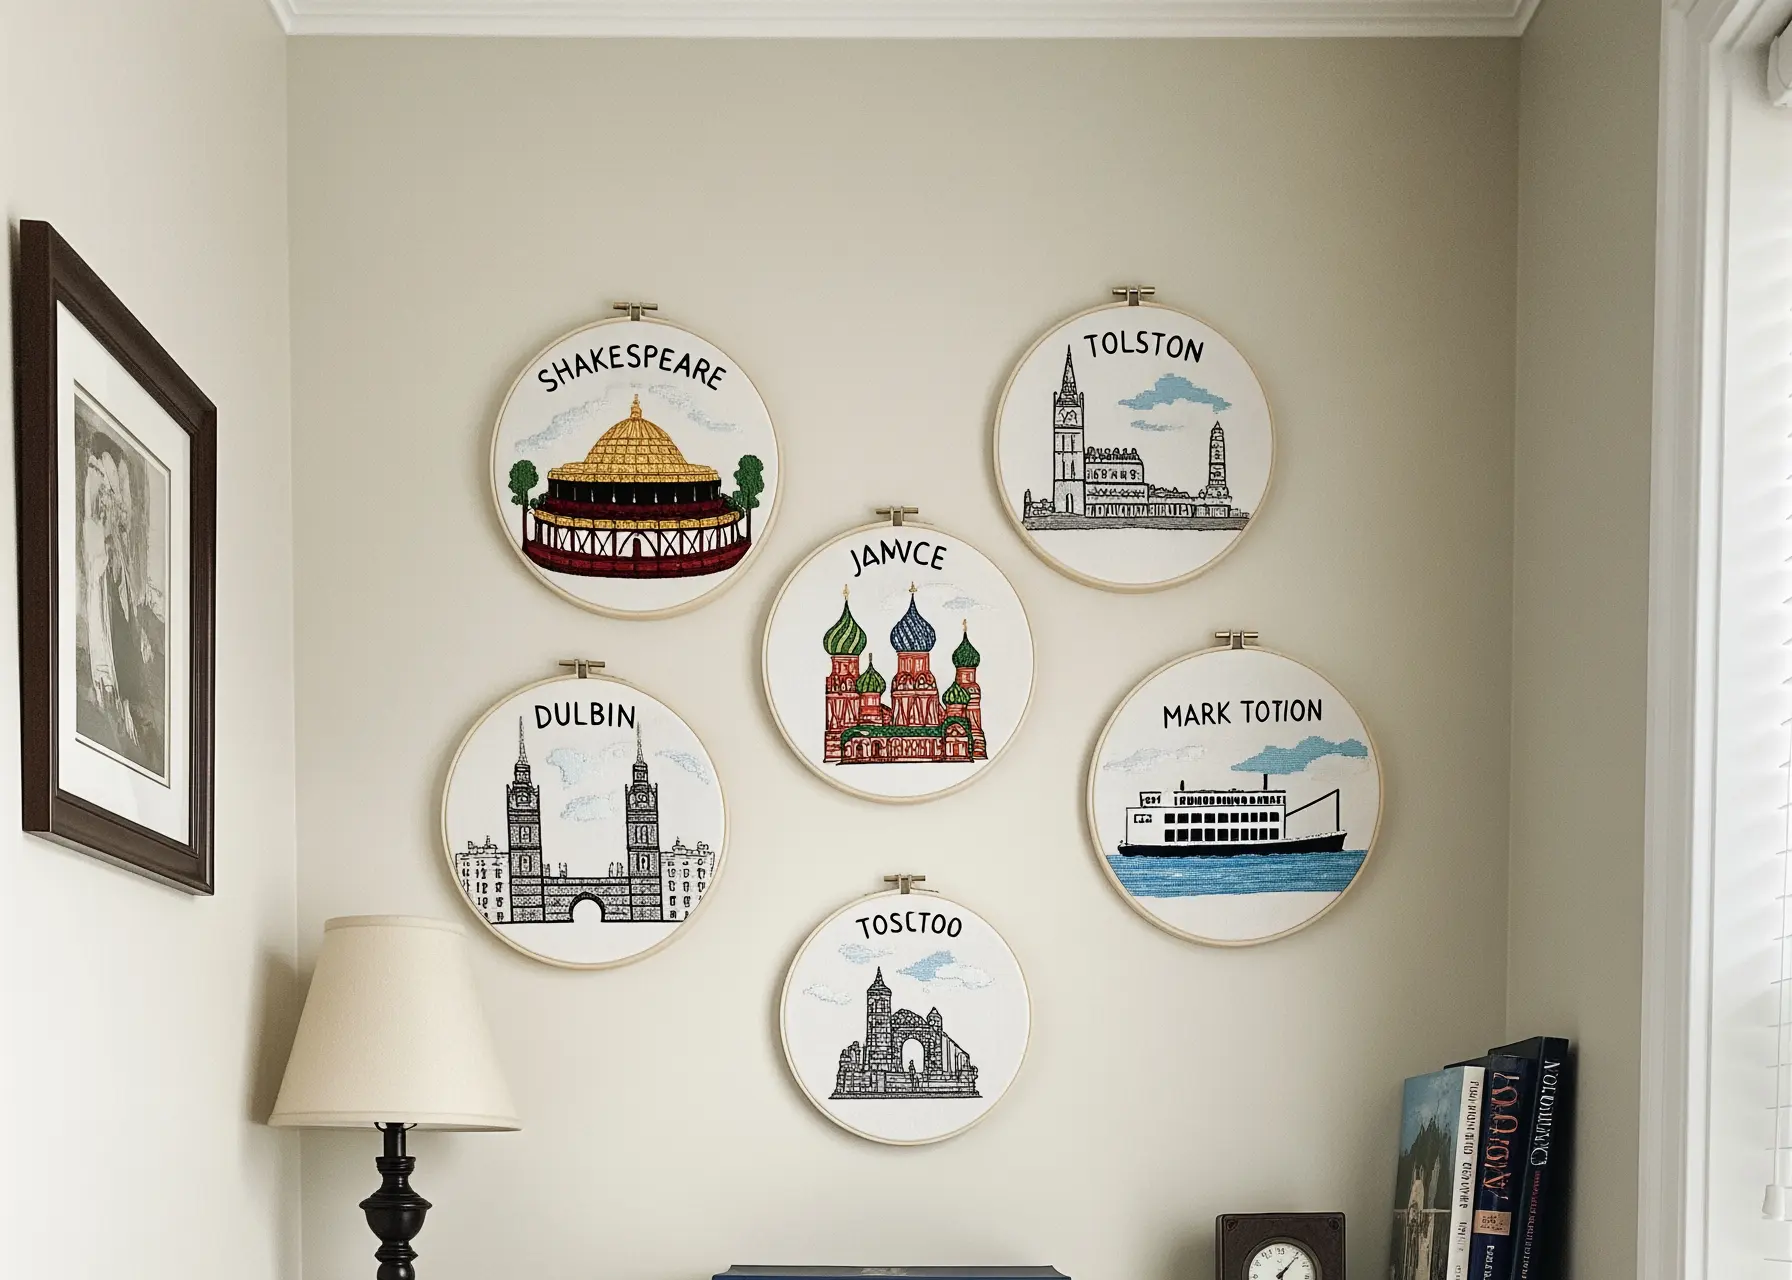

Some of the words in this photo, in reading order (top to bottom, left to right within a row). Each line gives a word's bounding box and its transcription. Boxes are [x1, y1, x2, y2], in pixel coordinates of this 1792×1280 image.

[1083, 330, 1204, 363] TOLSTON
[537, 343, 727, 393] SHAKESPEARE
[534, 701, 636, 729] DULBIN
[1163, 700, 1232, 729] MARK
[1239, 698, 1322, 724] TOTION
